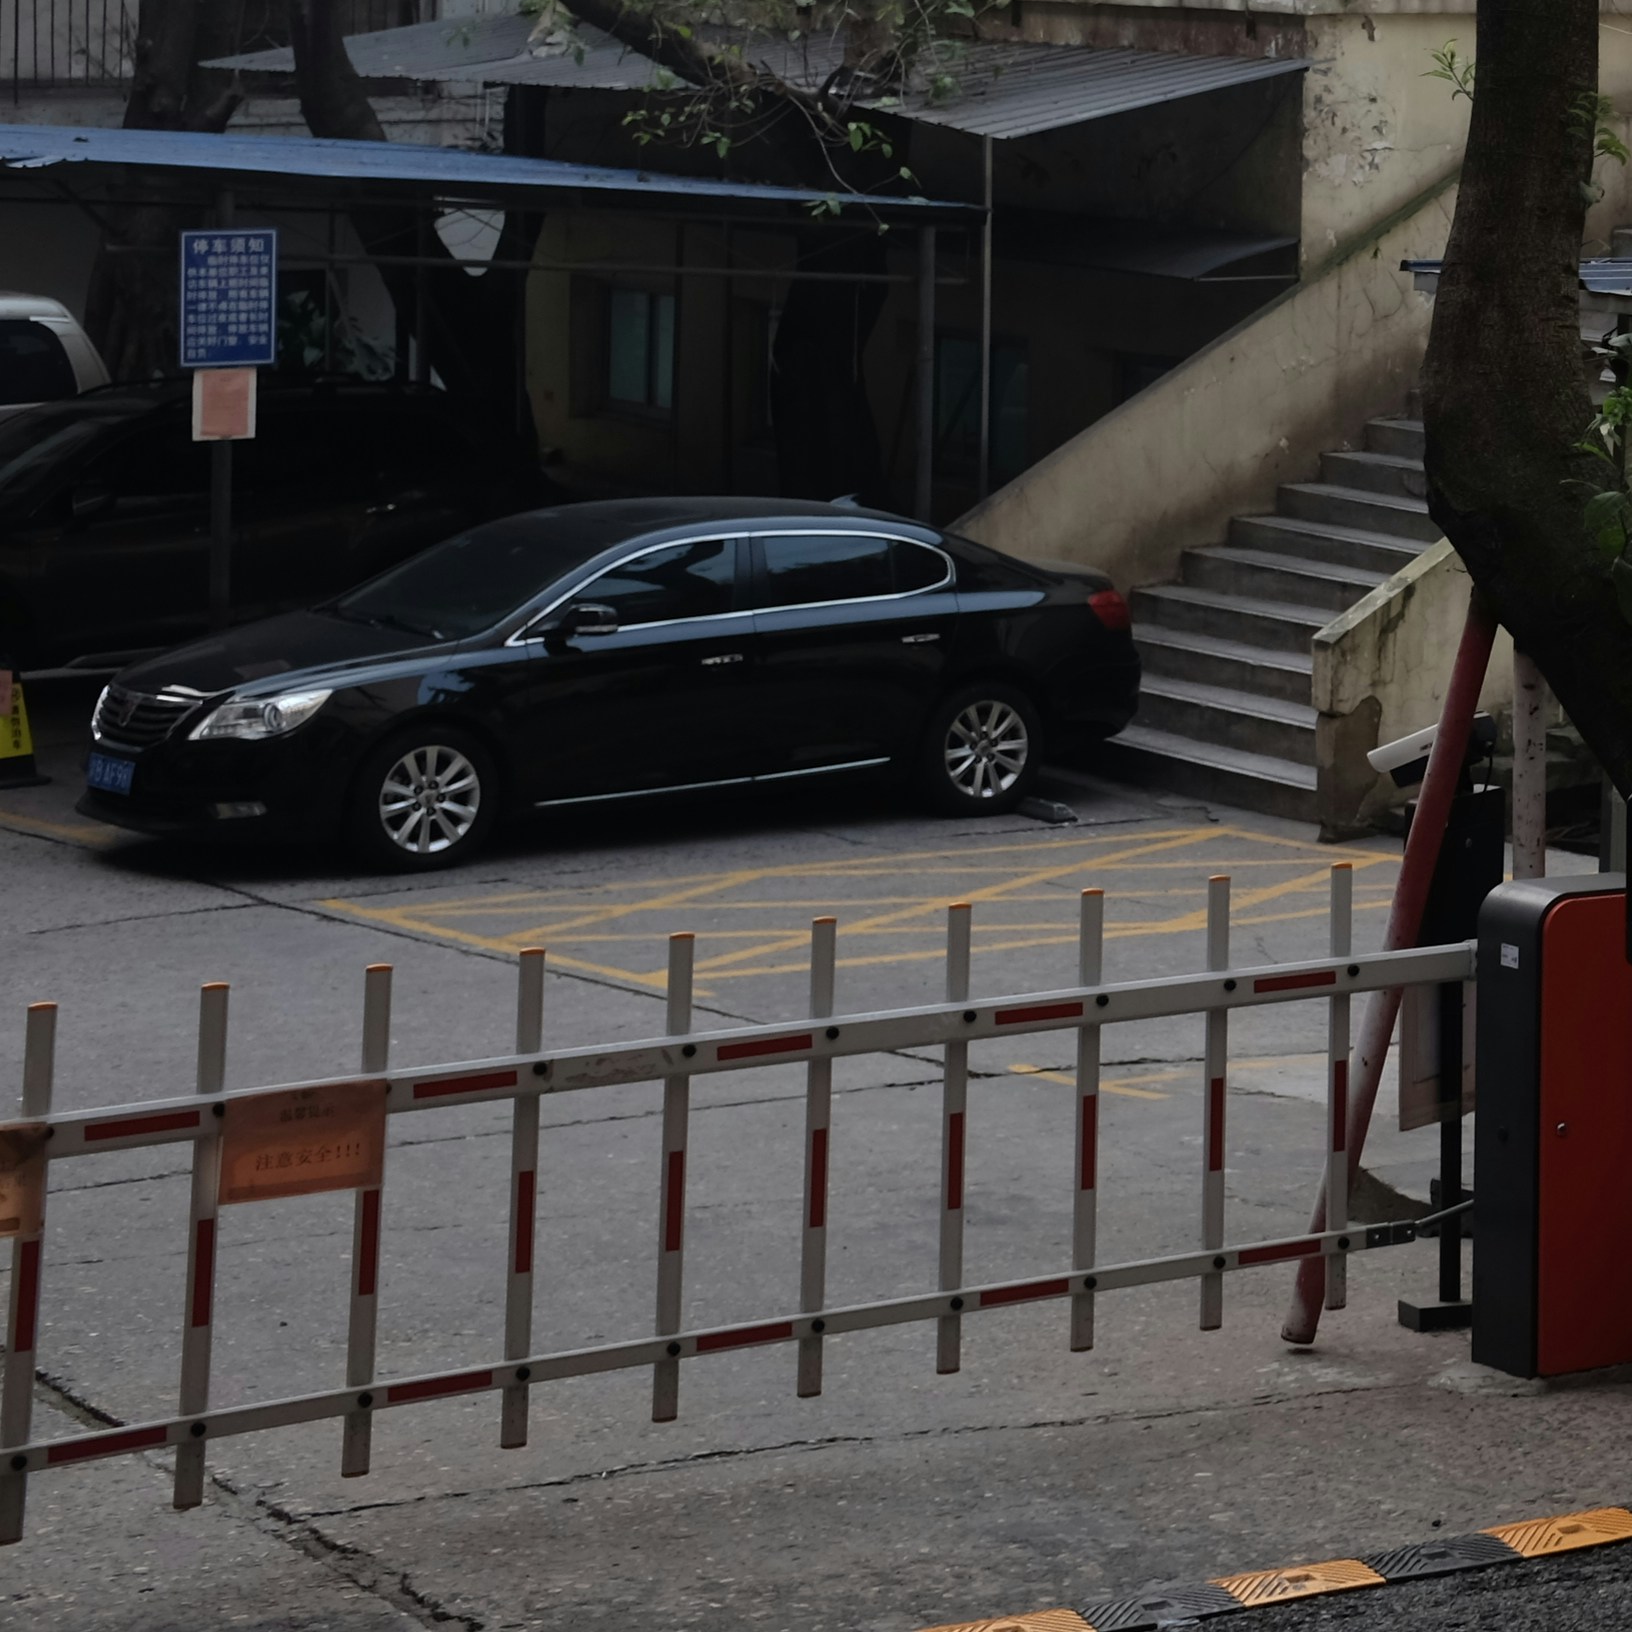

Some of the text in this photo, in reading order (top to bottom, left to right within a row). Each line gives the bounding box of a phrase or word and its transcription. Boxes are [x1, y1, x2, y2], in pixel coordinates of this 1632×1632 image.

[193, 237, 264, 254] 停车须知
[281, 1105, 336, 1122] 温馨提示
